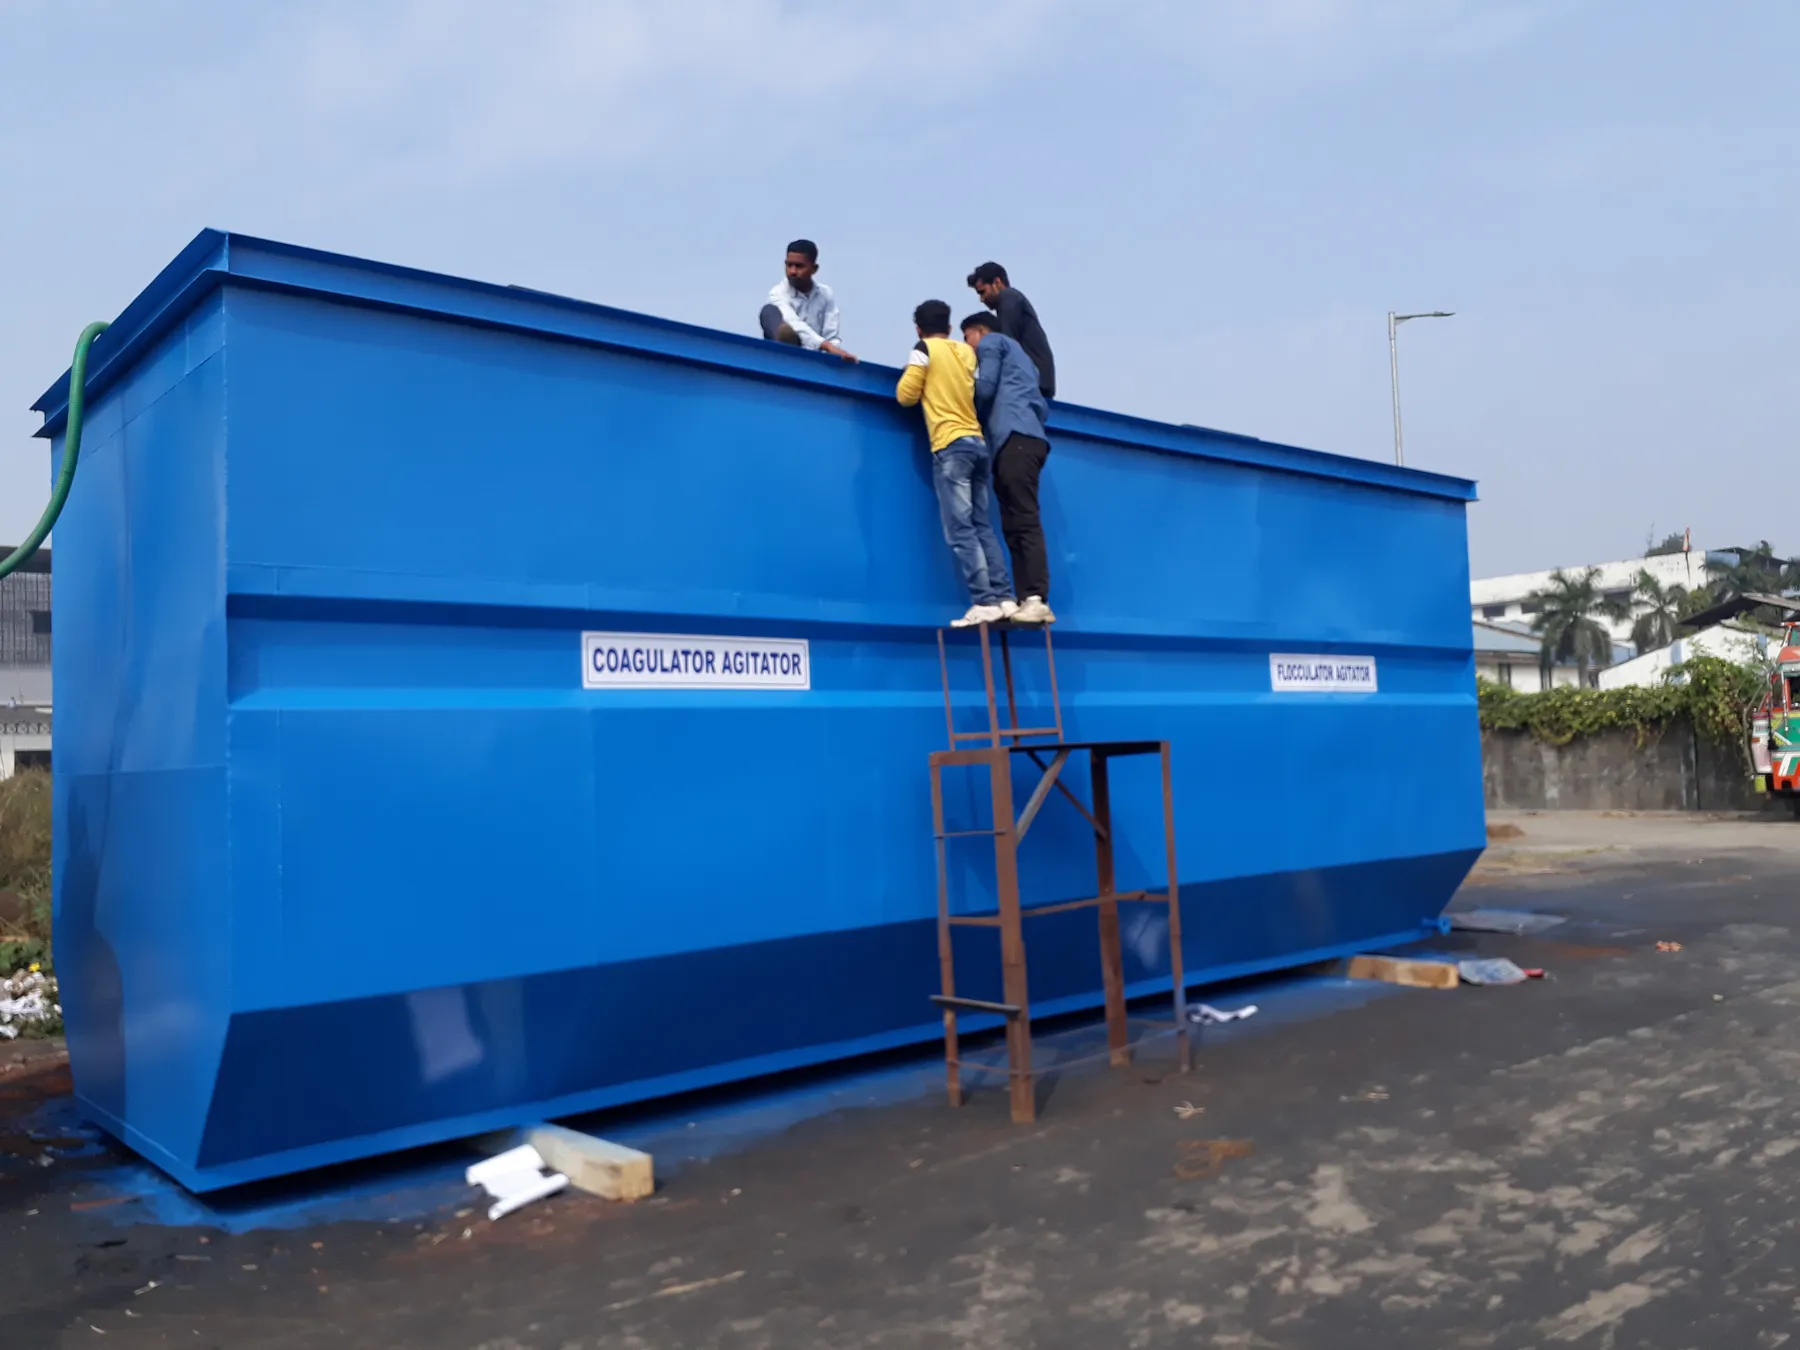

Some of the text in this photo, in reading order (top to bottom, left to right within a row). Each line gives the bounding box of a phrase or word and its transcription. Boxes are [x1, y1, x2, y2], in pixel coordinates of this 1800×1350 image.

[593, 647, 802, 676] COAGULATOR AGITATOR
[1277, 663, 1370, 682] FLOCCULATOR AGITATOR
